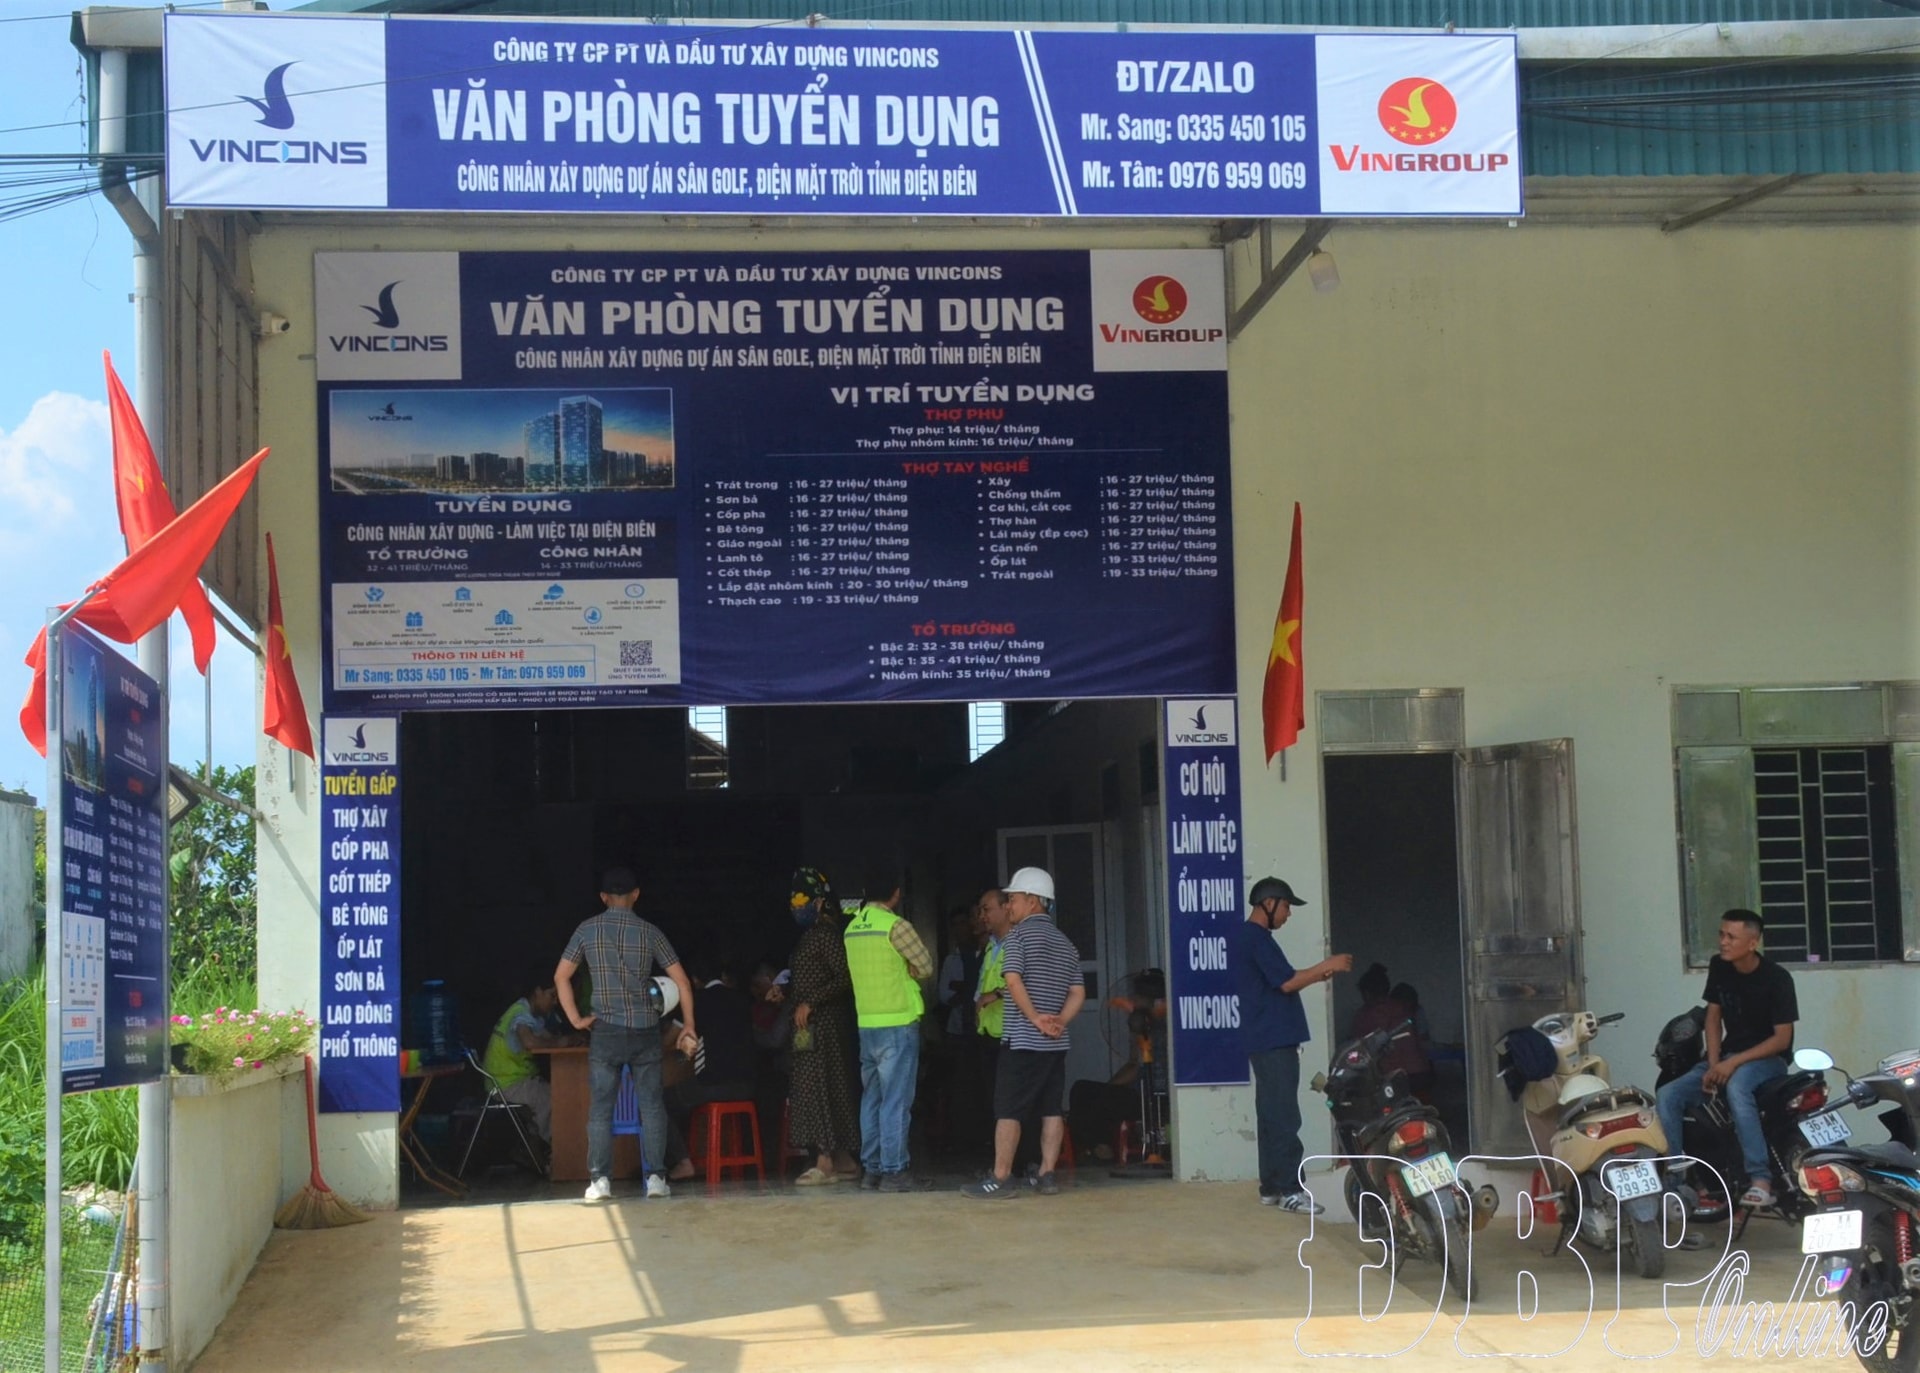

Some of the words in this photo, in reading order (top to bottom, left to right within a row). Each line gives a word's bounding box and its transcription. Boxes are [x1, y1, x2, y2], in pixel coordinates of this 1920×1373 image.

[493, 36, 548, 61] CÔNG
[553, 41, 576, 62] TY
[582, 42, 608, 63] CP
[615, 43, 639, 63] PT
[644, 39, 670, 64] VÀ
[720, 43, 746, 65] TƯ
[750, 41, 788, 65] XÂY
[794, 44, 847, 71] DỰNG
[853, 46, 939, 68] VINCONS
[1116, 60, 1254, 93] ĐT/ZALO
[432, 78, 526, 141] VĂN
[543, 78, 700, 144] PHÒNG
[715, 74, 860, 146] TUYỂN
[875, 95, 999, 159] DỤNG
[1081, 113, 1111, 140] Mr.
[1117, 113, 1171, 144] Sang:
[1177, 114, 1224, 141] 0335
[1229, 114, 1265, 141] 450
[1271, 114, 1305, 141] 105
[189, 138, 366, 164] VINCONS
[1329, 141, 1508, 171] VINGROUP
[457, 158, 498, 192] CÔNG
[503, 159, 545, 192] NHÂN
[549, 160, 578, 192] XÂY
[582, 163, 623, 199] DỰNG
[627, 163, 649, 199] DỰ
[651, 161, 672, 193] ÁN
[677, 161, 707, 194] SÂN
[756, 162, 791, 200] ĐIỆN
[795, 163, 827, 200] MẶT
[830, 162, 863, 195] TRỜI
[867, 160, 900, 195] TỈNH
[904, 163, 938, 201] ĐIỆN
[942, 163, 977, 195] BIÊN
[1082, 160, 1114, 187] Mr.
[1120, 160, 1163, 188] Tân:
[1169, 161, 1219, 188] 0976
[1225, 161, 1262, 188] 959
[1268, 161, 1306, 189] 069
[551, 266, 605, 283] CÔNG
[612, 269, 634, 282] TY
[641, 268, 667, 282] CP
[674, 268, 697, 282] PT
[704, 265, 729, 282] VÀ
[781, 266, 807, 281] TƯ
[811, 264, 849, 281] XÂY
[855, 265, 909, 283] DỰNG
[915, 266, 1002, 280] VINCONS
[490, 293, 585, 335] VĂN
[602, 290, 761, 334] PHÒNG
[776, 285, 922, 333] TUYỂN
[939, 297, 1063, 339] DỤNG
[329, 334, 447, 352] VINCONS
[1099, 323, 1224, 344] VINGROUP
[515, 346, 557, 368] CÔNG
[561, 346, 603, 368] NHÂN
[608, 346, 637, 368] XÂY
[642, 347, 683, 371] DỰNG
[687, 347, 709, 370] DỰ
[711, 345, 733, 367] ÁN
[737, 345, 768, 366] SÂN
[818, 344, 853, 369] ĐIỆN
[857, 344, 889, 369] MẶT
[893, 343, 925, 365] TRỜI
[929, 341, 963, 364] TỈNH
[967, 342, 1002, 367] ĐIỆN
[1006, 342, 1041, 363] BIÊN
[830, 386, 858, 407] VỊ
[865, 383, 910, 403] TRÍ
[916, 380, 1008, 403] TUYỂN
[1016, 383, 1094, 405] DỤNG
[435, 496, 506, 513] TUYỂN
[512, 495, 571, 514] DỤNG
[347, 523, 383, 541] CÔNG
[389, 522, 425, 540] NHÂN
[429, 522, 454, 540] XÂY
[458, 523, 493, 543] DỰNG
[506, 521, 533, 539] LÀM
[537, 520, 565, 542] VIỆC
[568, 523, 588, 541] TẠI
[592, 520, 622, 541] ĐIỆN
[626, 519, 655, 537] BIÊN
[367, 546, 390, 560] TỔ
[395, 545, 468, 559] TRƯỞNG
[539, 545, 588, 558] CÔNG
[593, 544, 642, 557] NHÂN
[412, 649, 455, 660] THÔNG
[459, 651, 477, 659] TIN
[481, 649, 505, 659] LIÊN
[509, 649, 524, 659] HỆ
[344, 669, 359, 682] Mr
[363, 668, 393, 683] Sang:
[396, 668, 423, 682] 0335
[425, 667, 446, 681] 450
[449, 667, 469, 680] 105
[480, 666, 493, 679] Mr
[496, 666, 516, 679] Tân:
[519, 665, 543, 679] 0976
[546, 665, 564, 678] 959
[567, 665, 585, 678] 069
[1175, 733, 1228, 743] VINCONS
[332, 752, 388, 762] VINCONS
[323, 768, 366, 795] TUYỂN
[369, 769, 396, 795] GẤP
[1180, 759, 1198, 796] CƠ
[1202, 755, 1225, 802] HỘI
[332, 807, 358, 832] THỢ
[361, 804, 387, 827] XÂY
[331, 834, 358, 860] CỐP
[362, 840, 389, 860] PHA
[1172, 814, 1202, 854] LÀM
[1205, 813, 1236, 860] VIỆC
[329, 867, 354, 893] CỐT
[357, 869, 391, 892] THÉP
[1178, 865, 1198, 912] ỔN
[1201, 878, 1234, 919] ĐỊNH
[332, 902, 349, 925] BÊ
[352, 902, 387, 925] TÔNG
[337, 932, 355, 958] ỐP
[359, 934, 383, 958] LÁT
[1189, 930, 1227, 970] CÙNG
[334, 970, 363, 991] SƠN
[366, 965, 384, 990] BẢ
[1179, 994, 1240, 1029] VINCONS
[322, 1030, 350, 1057] PHỔ
[352, 1033, 397, 1057] THÔNG
[1615, 1164, 1649, 1182] 36-B5
[1616, 1177, 1658, 1198] 299.39
